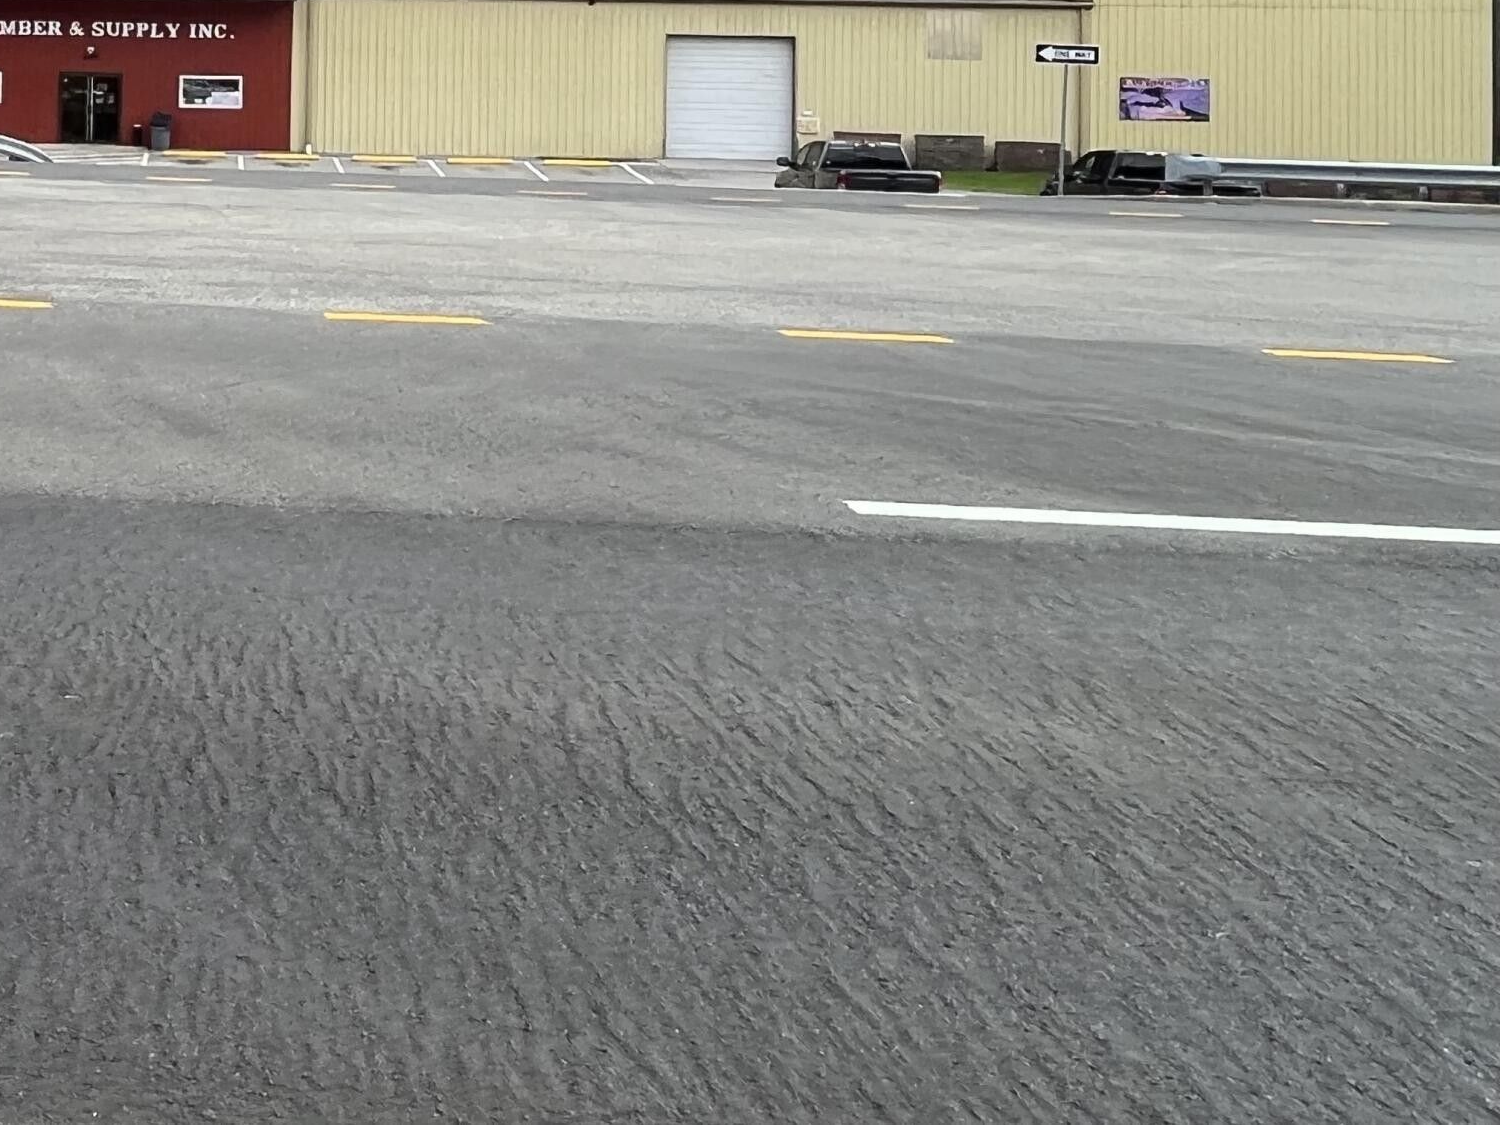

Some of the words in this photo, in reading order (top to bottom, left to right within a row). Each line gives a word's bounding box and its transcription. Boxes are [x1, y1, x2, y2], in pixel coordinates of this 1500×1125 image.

[69, 21, 85, 37] &
[91, 21, 180, 39] SUPPLY
[189, 23, 235, 40] INC.
